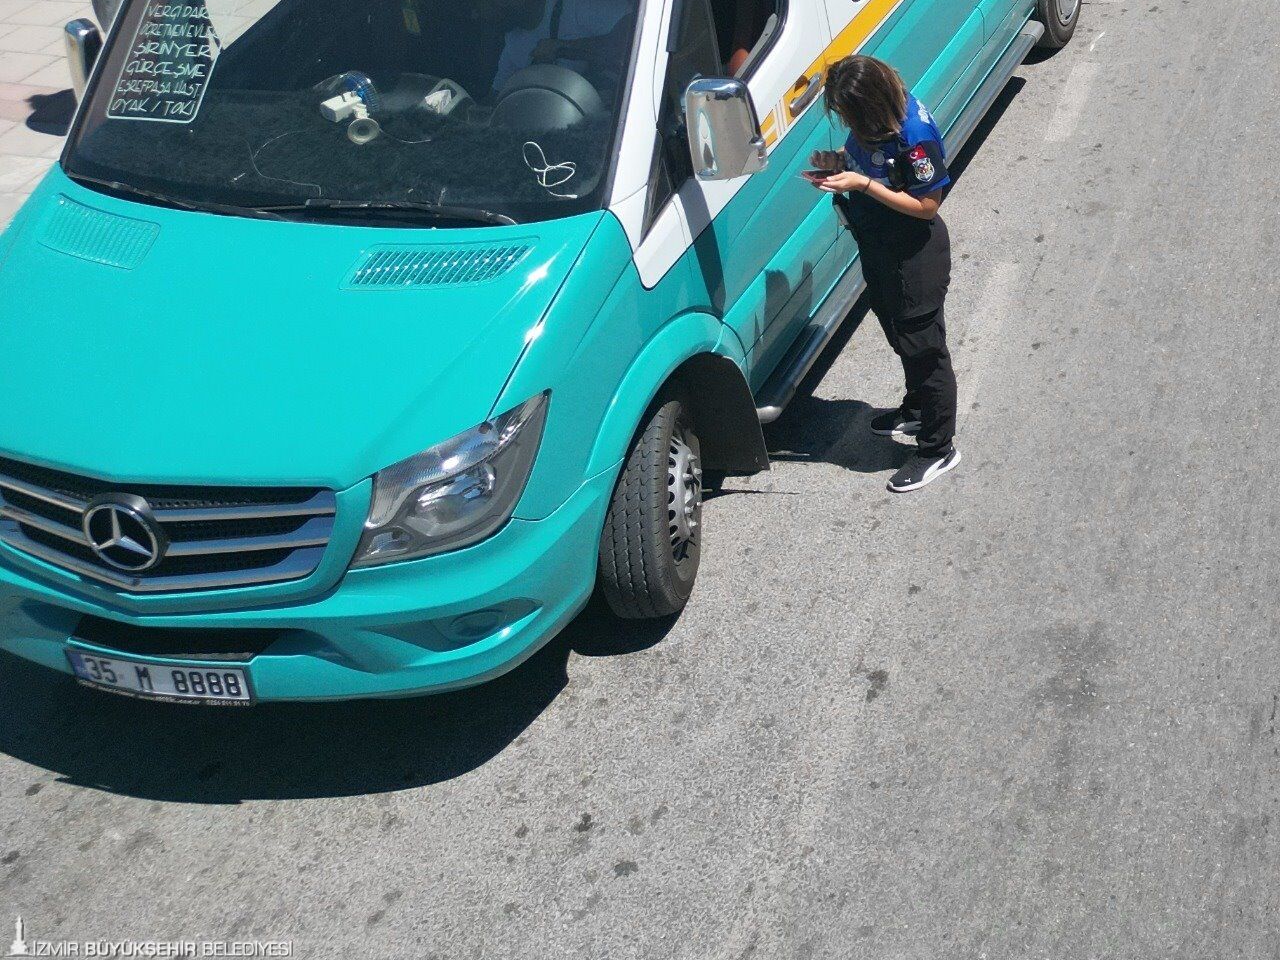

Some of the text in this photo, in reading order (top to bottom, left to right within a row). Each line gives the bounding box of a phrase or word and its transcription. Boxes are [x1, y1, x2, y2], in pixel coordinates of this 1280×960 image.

[133, 40, 212, 58] ŞİRİNYER
[126, 58, 205, 79] GÜRÇEŞME
[111, 97, 151, 114] OYAK
[83, 656, 118, 684] 35
[134, 665, 155, 691] M
[171, 670, 242, 697] 8888
